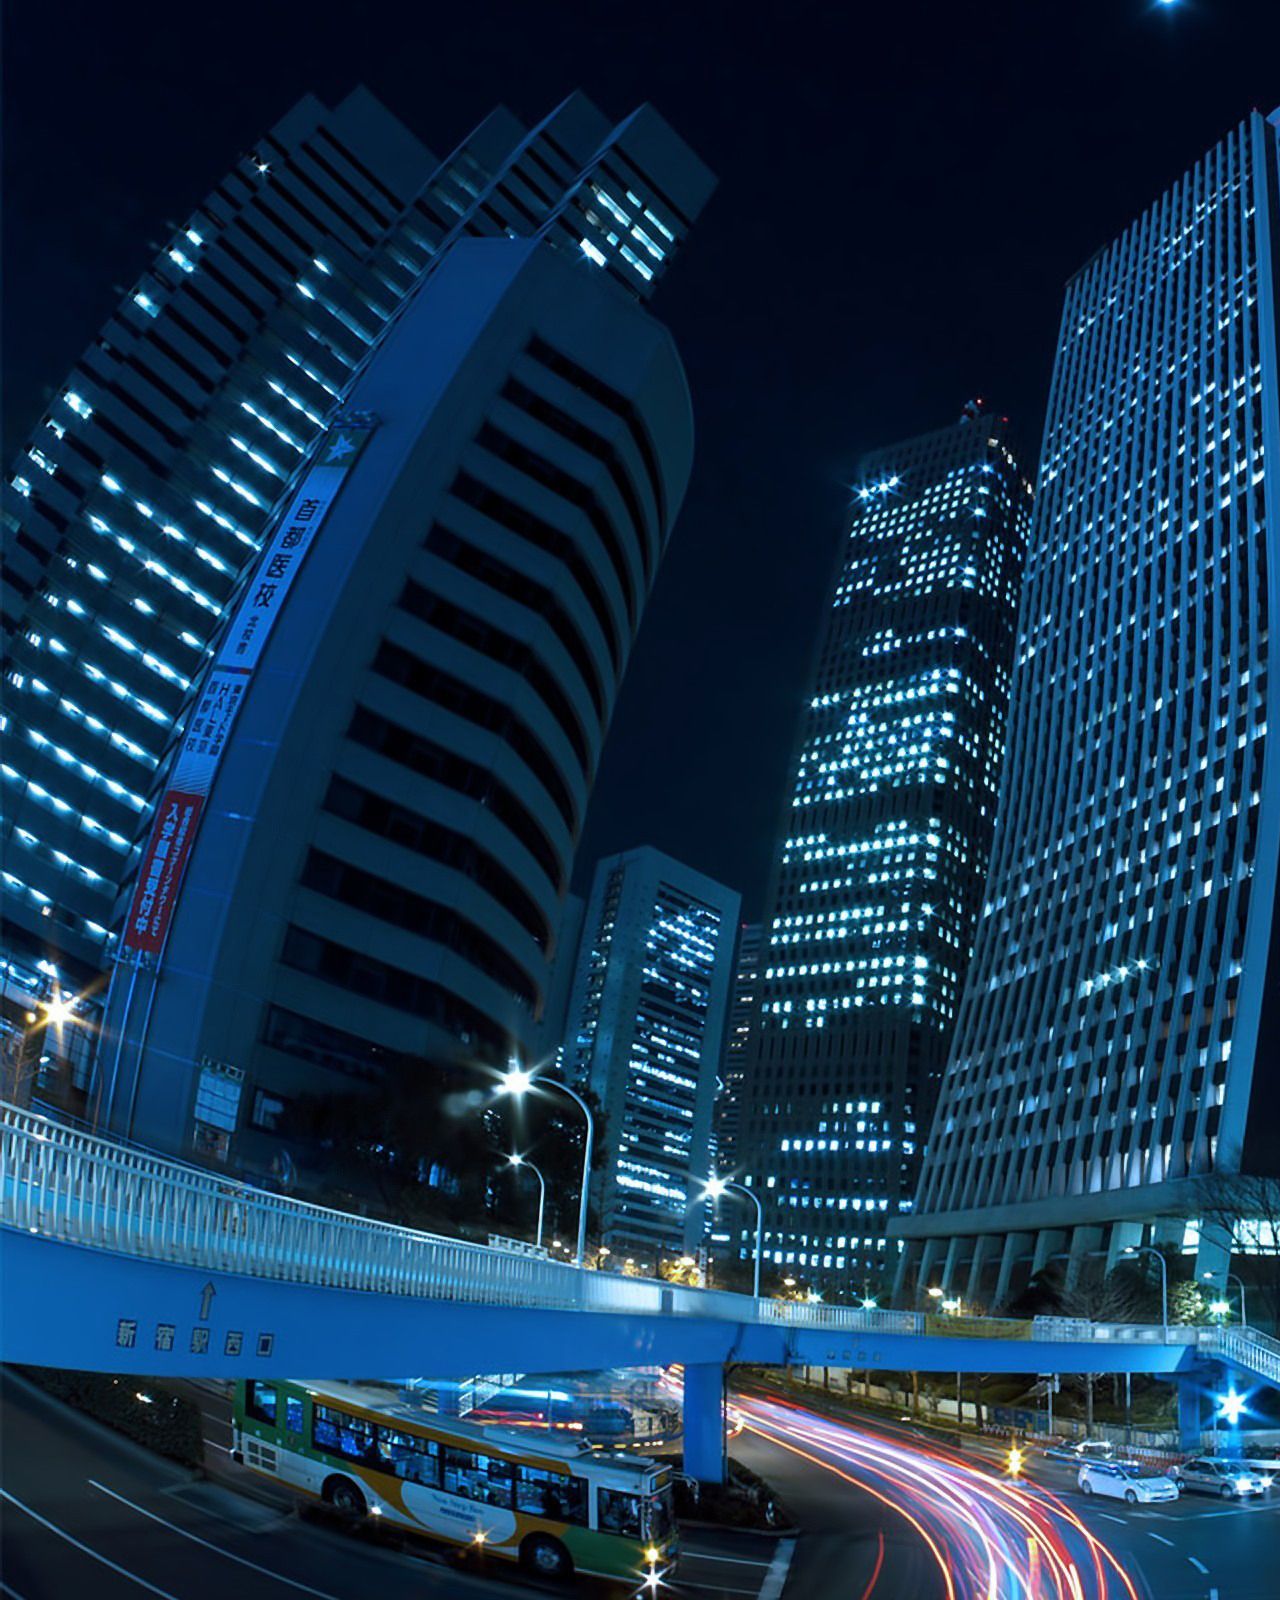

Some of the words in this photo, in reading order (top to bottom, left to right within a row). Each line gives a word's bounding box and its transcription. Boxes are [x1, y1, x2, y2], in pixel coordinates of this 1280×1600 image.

[116, 1319, 275, 1357] 新宿駅西口
